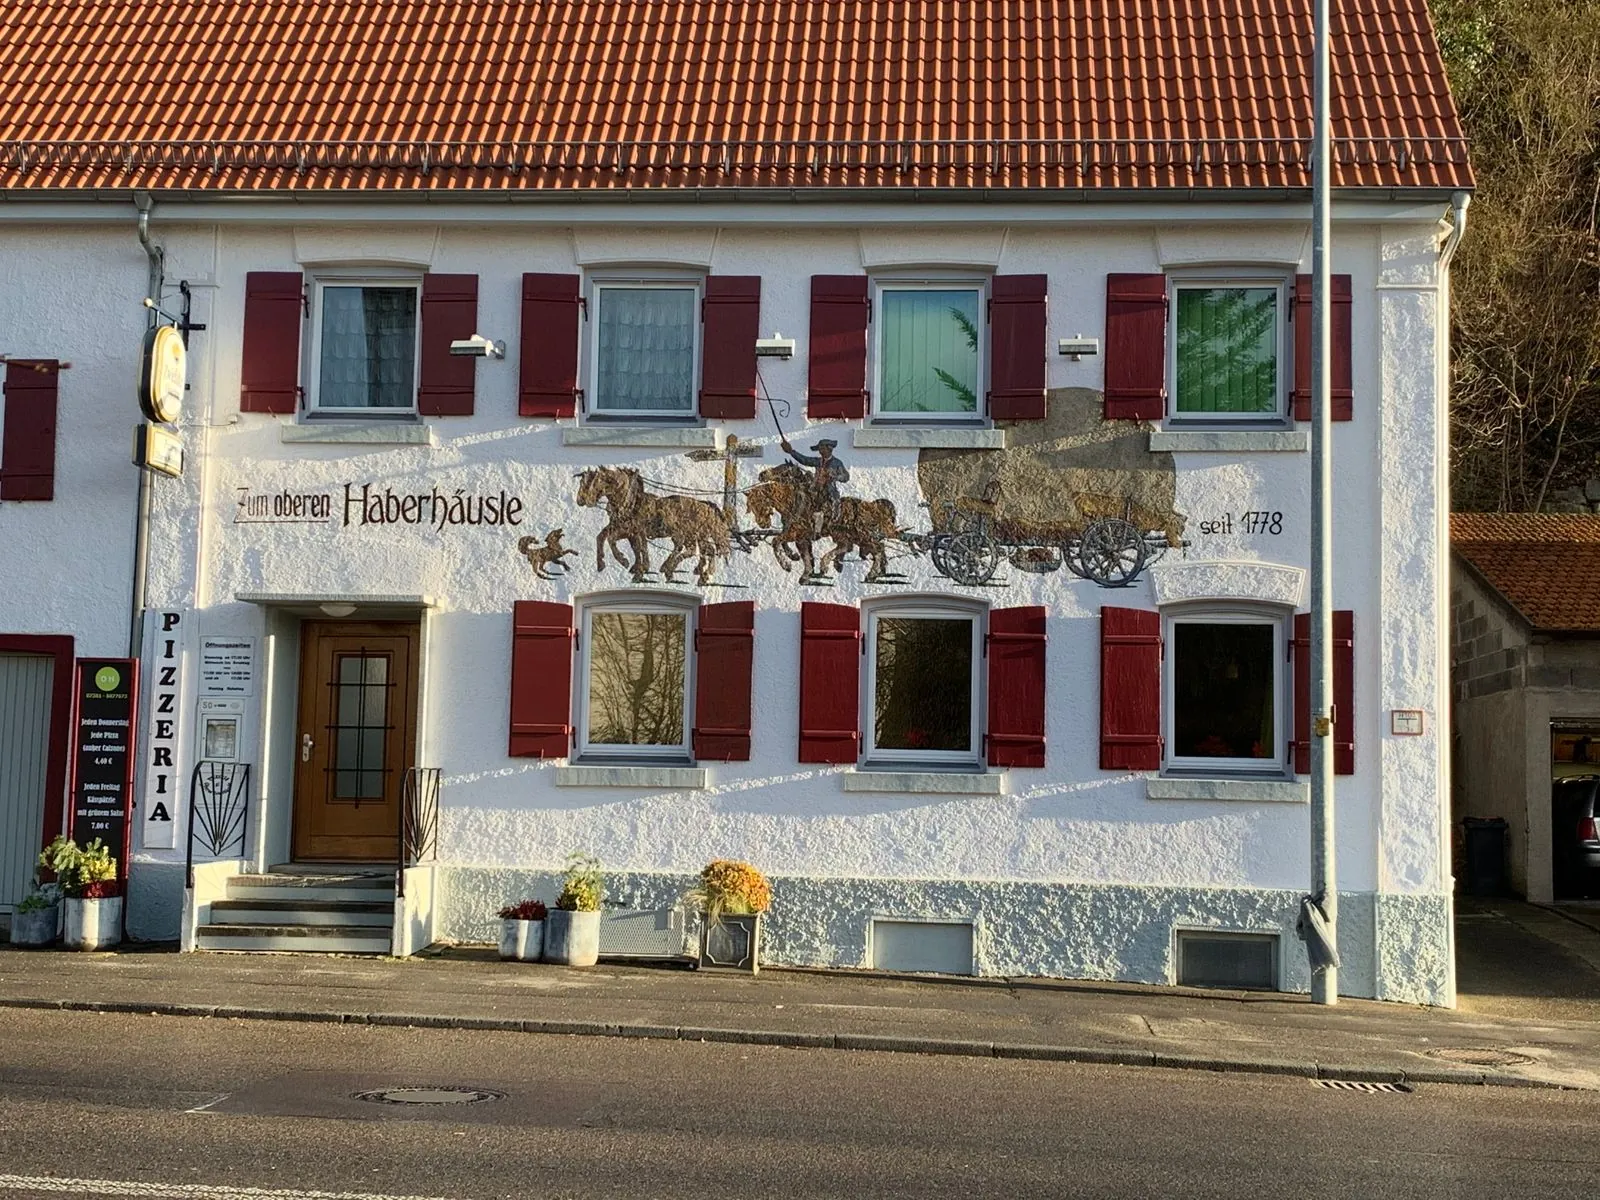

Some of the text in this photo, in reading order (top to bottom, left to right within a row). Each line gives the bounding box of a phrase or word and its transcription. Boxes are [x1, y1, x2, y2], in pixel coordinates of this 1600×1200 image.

[234, 482, 522, 533] Zum oberen Haberhäusle
[1200, 511, 1283, 535] seit 1778
[149, 612, 180, 822] PIZZERIA
